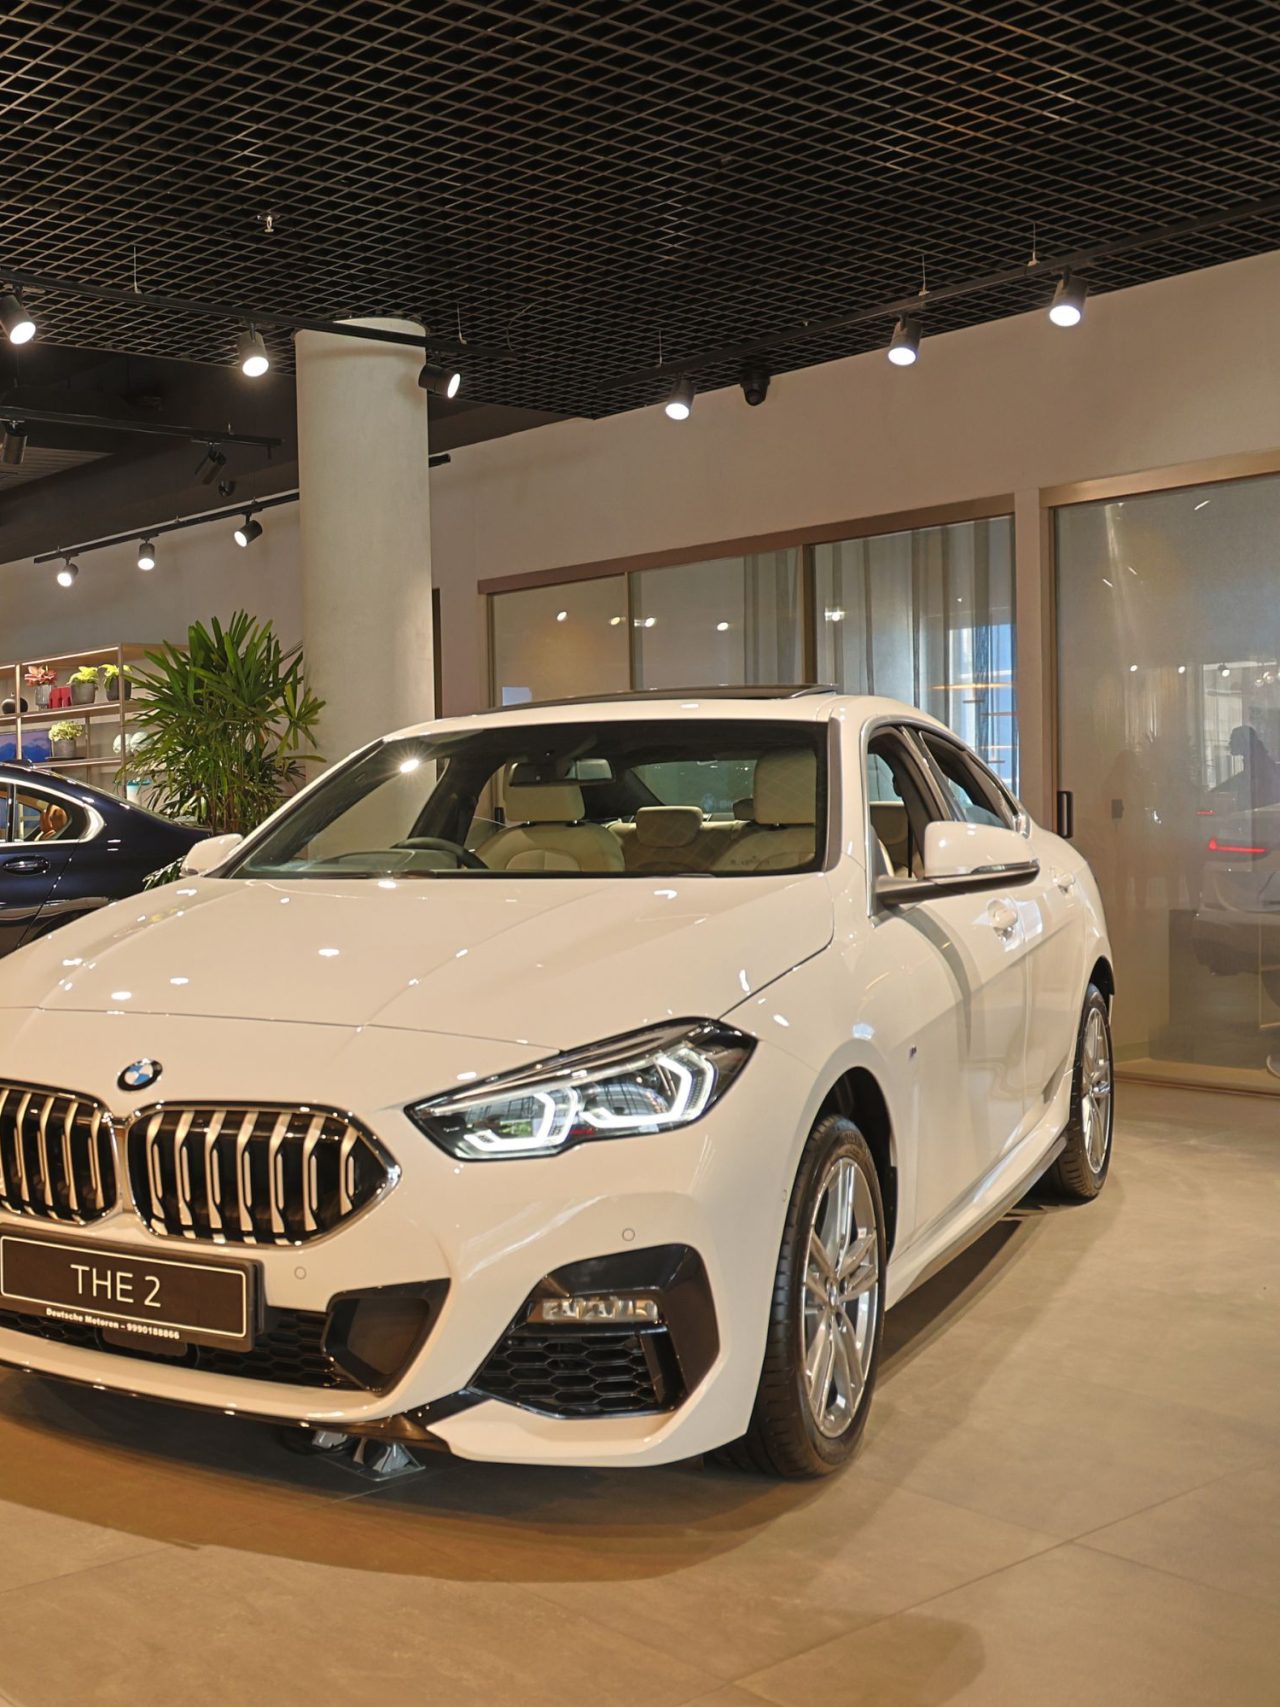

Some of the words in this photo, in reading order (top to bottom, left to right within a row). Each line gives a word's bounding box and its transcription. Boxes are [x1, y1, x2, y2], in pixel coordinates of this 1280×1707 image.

[70, 1264, 134, 1303] THE
[144, 1276, 161, 1307] 2
[46, 1307, 84, 1322] Deutsche
[85, 1315, 119, 1329] Motoren
